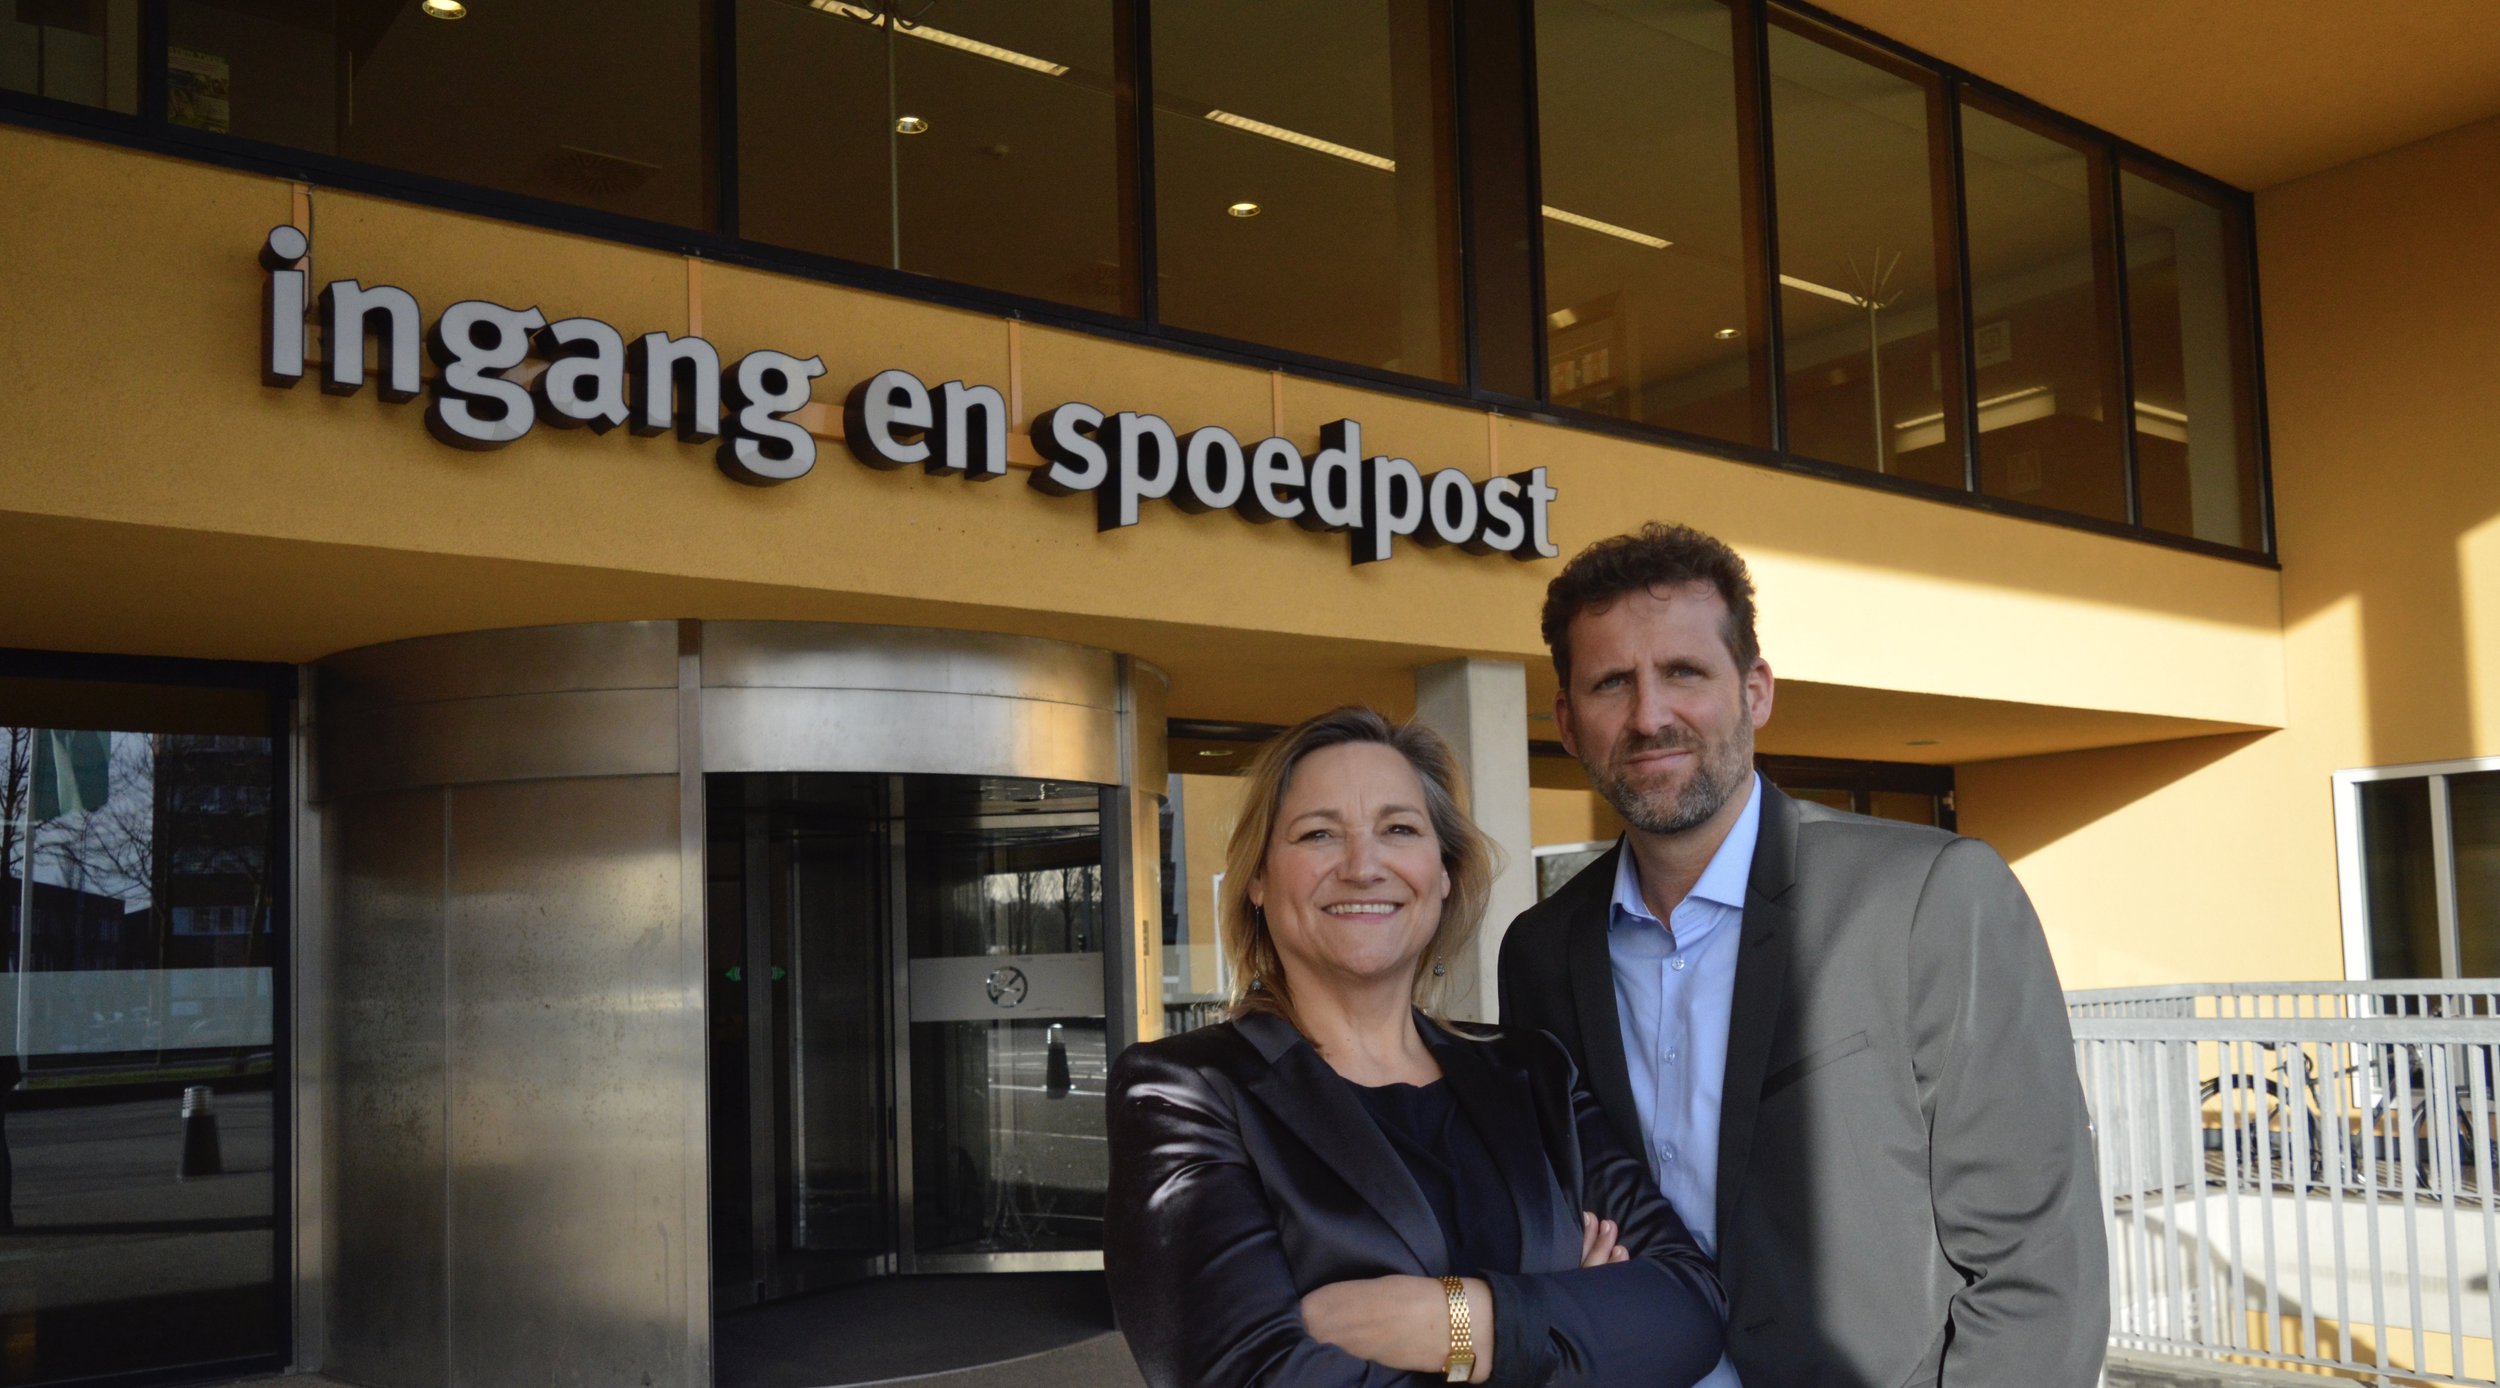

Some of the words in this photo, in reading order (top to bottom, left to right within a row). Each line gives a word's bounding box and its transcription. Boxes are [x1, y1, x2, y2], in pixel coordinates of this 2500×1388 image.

[268, 224, 828, 481] ingang
[860, 368, 1008, 477] en
[1045, 401, 1559, 562] spoedpost
